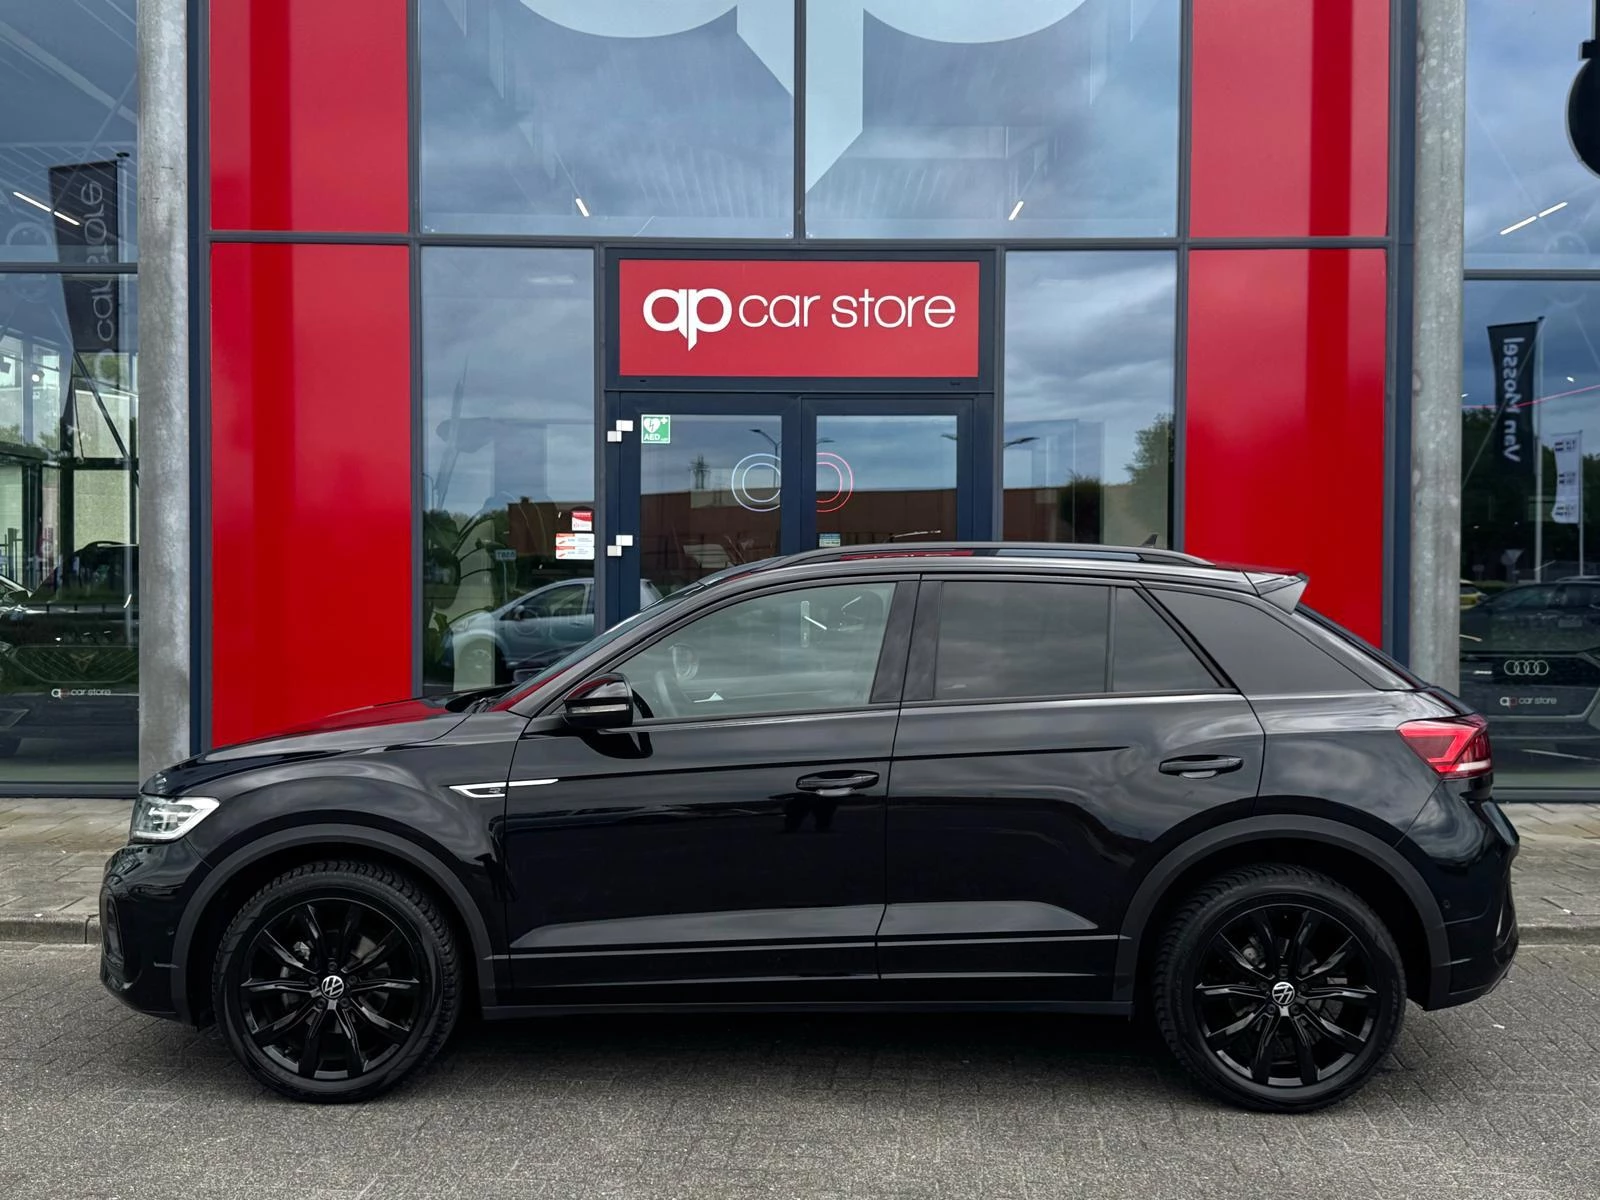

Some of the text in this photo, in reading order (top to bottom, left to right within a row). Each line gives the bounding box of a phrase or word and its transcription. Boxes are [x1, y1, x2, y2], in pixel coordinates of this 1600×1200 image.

[738, 294, 821, 328] car
[831, 288, 956, 328] store
[88, 688, 111, 696] store
[1518, 697, 1534, 705] car
[1534, 697, 1557, 705] store
